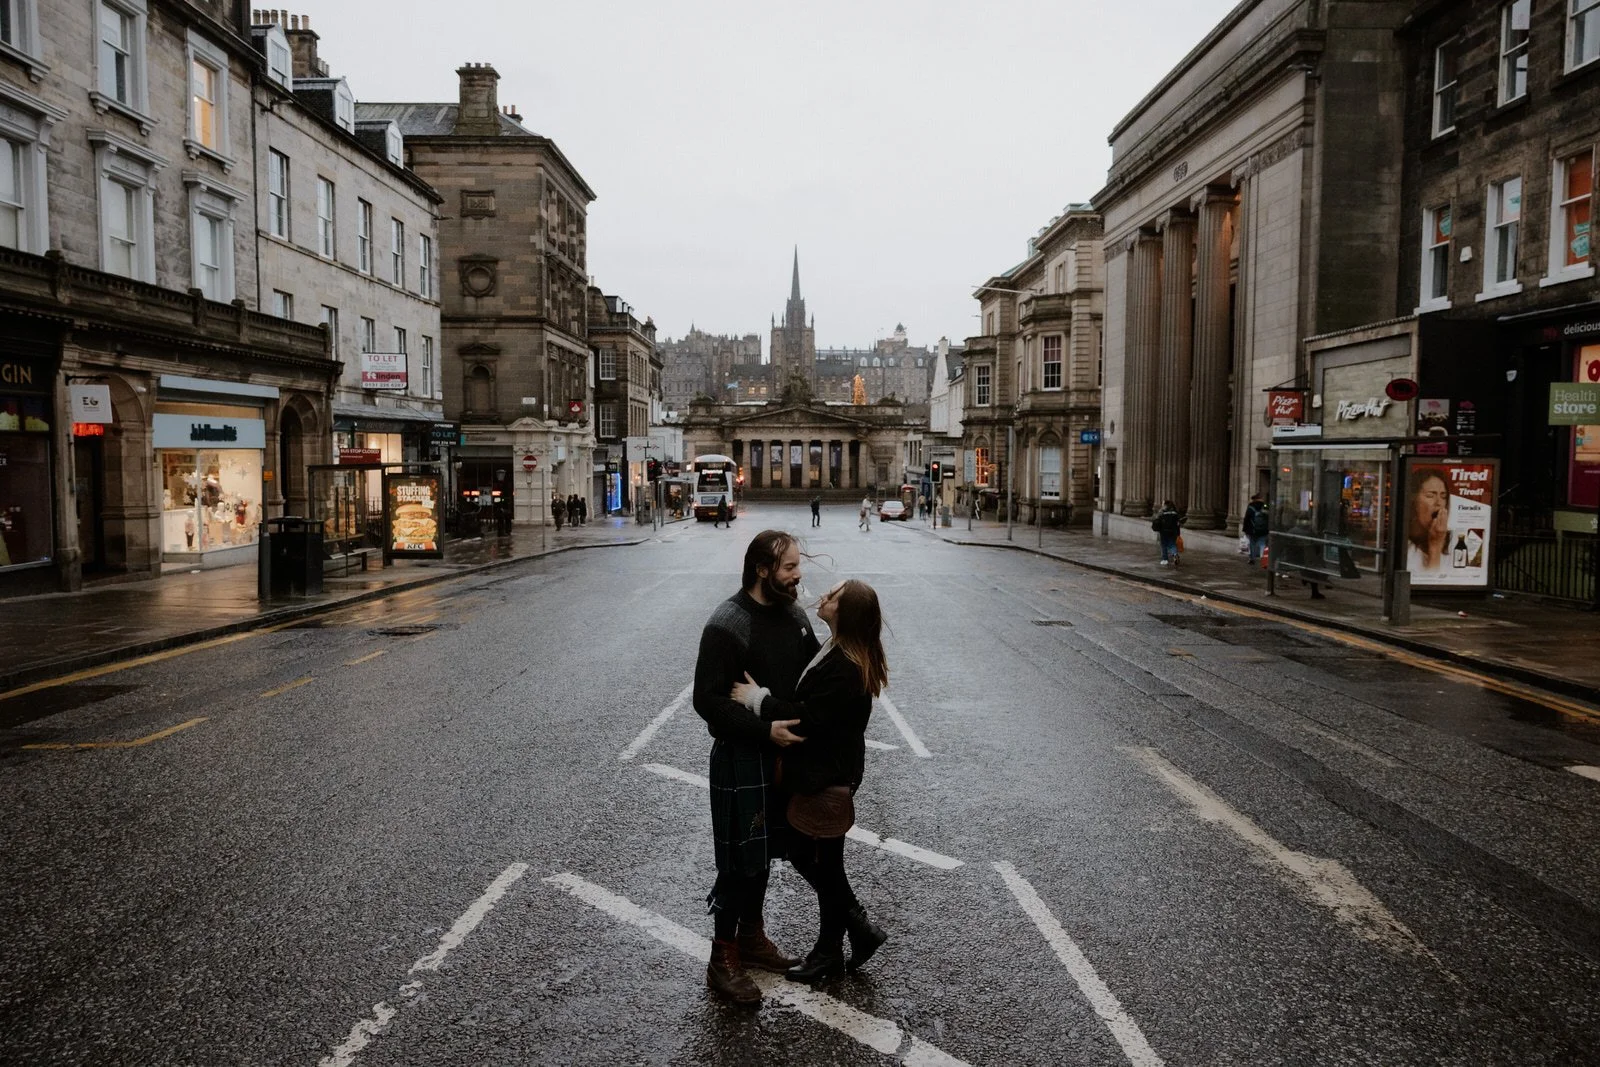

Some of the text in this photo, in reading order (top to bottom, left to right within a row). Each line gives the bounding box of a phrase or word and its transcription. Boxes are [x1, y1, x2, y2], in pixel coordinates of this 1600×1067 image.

[1, 363, 32, 384] GIN
[1272, 395, 1298, 406] Pizza
[1555, 390, 1596, 402] Health
[1274, 405, 1295, 415] Hut
[1336, 397, 1391, 421] Pizza Hut
[1553, 402, 1597, 414] store
[1450, 469, 1489, 481] Tired
[397, 486, 431, 496] STUFFING
[1459, 488, 1484, 496] Tired?
